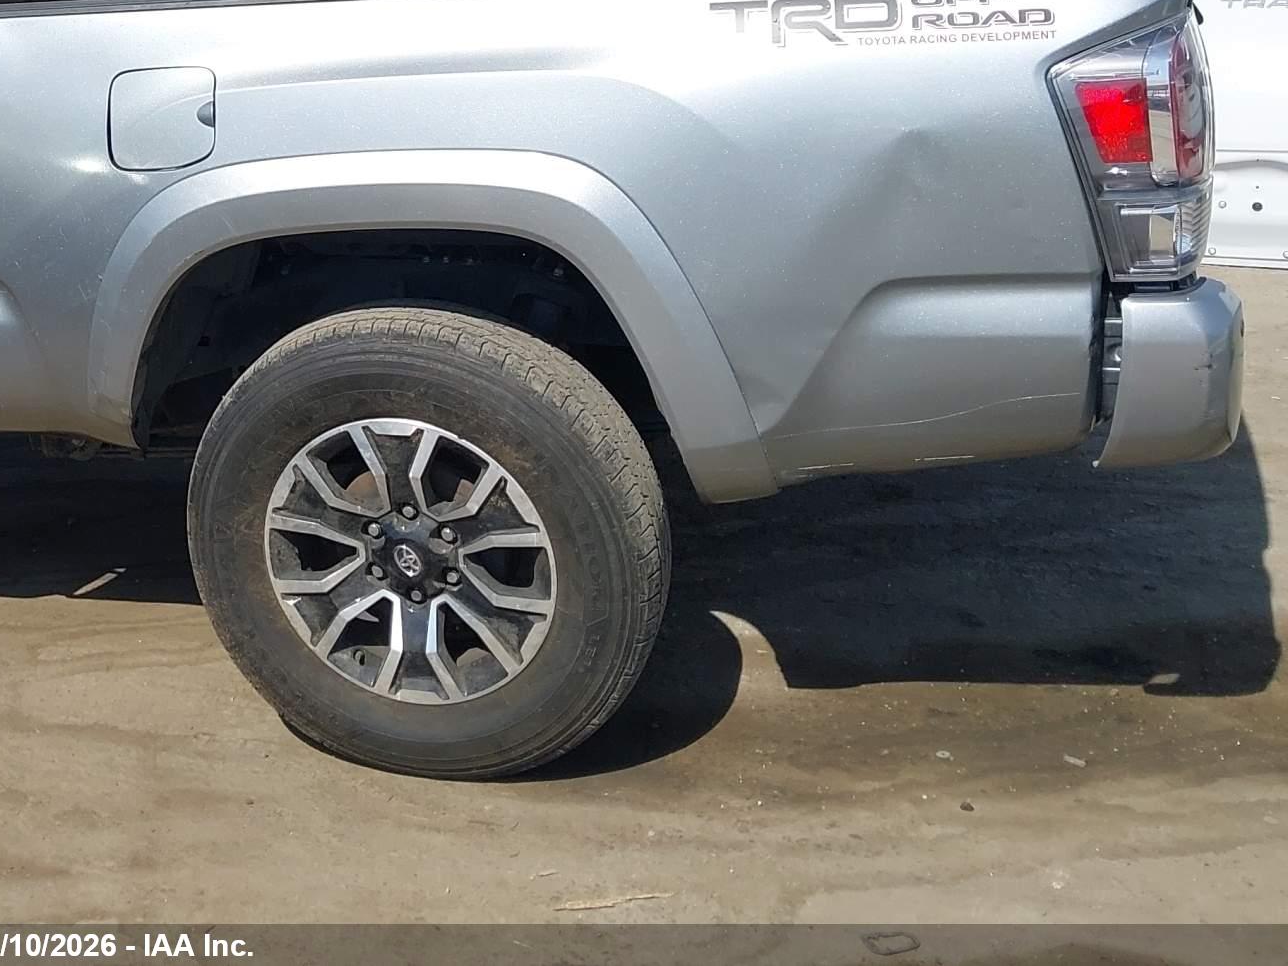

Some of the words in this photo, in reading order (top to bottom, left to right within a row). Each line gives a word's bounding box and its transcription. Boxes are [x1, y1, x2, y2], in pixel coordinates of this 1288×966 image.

[912, 8, 1056, 31] ROAD
[857, 36, 906, 47] TOYOTA
[910, 34, 958, 45] RACING
[961, 30, 1058, 43] DEVELOPMENT
